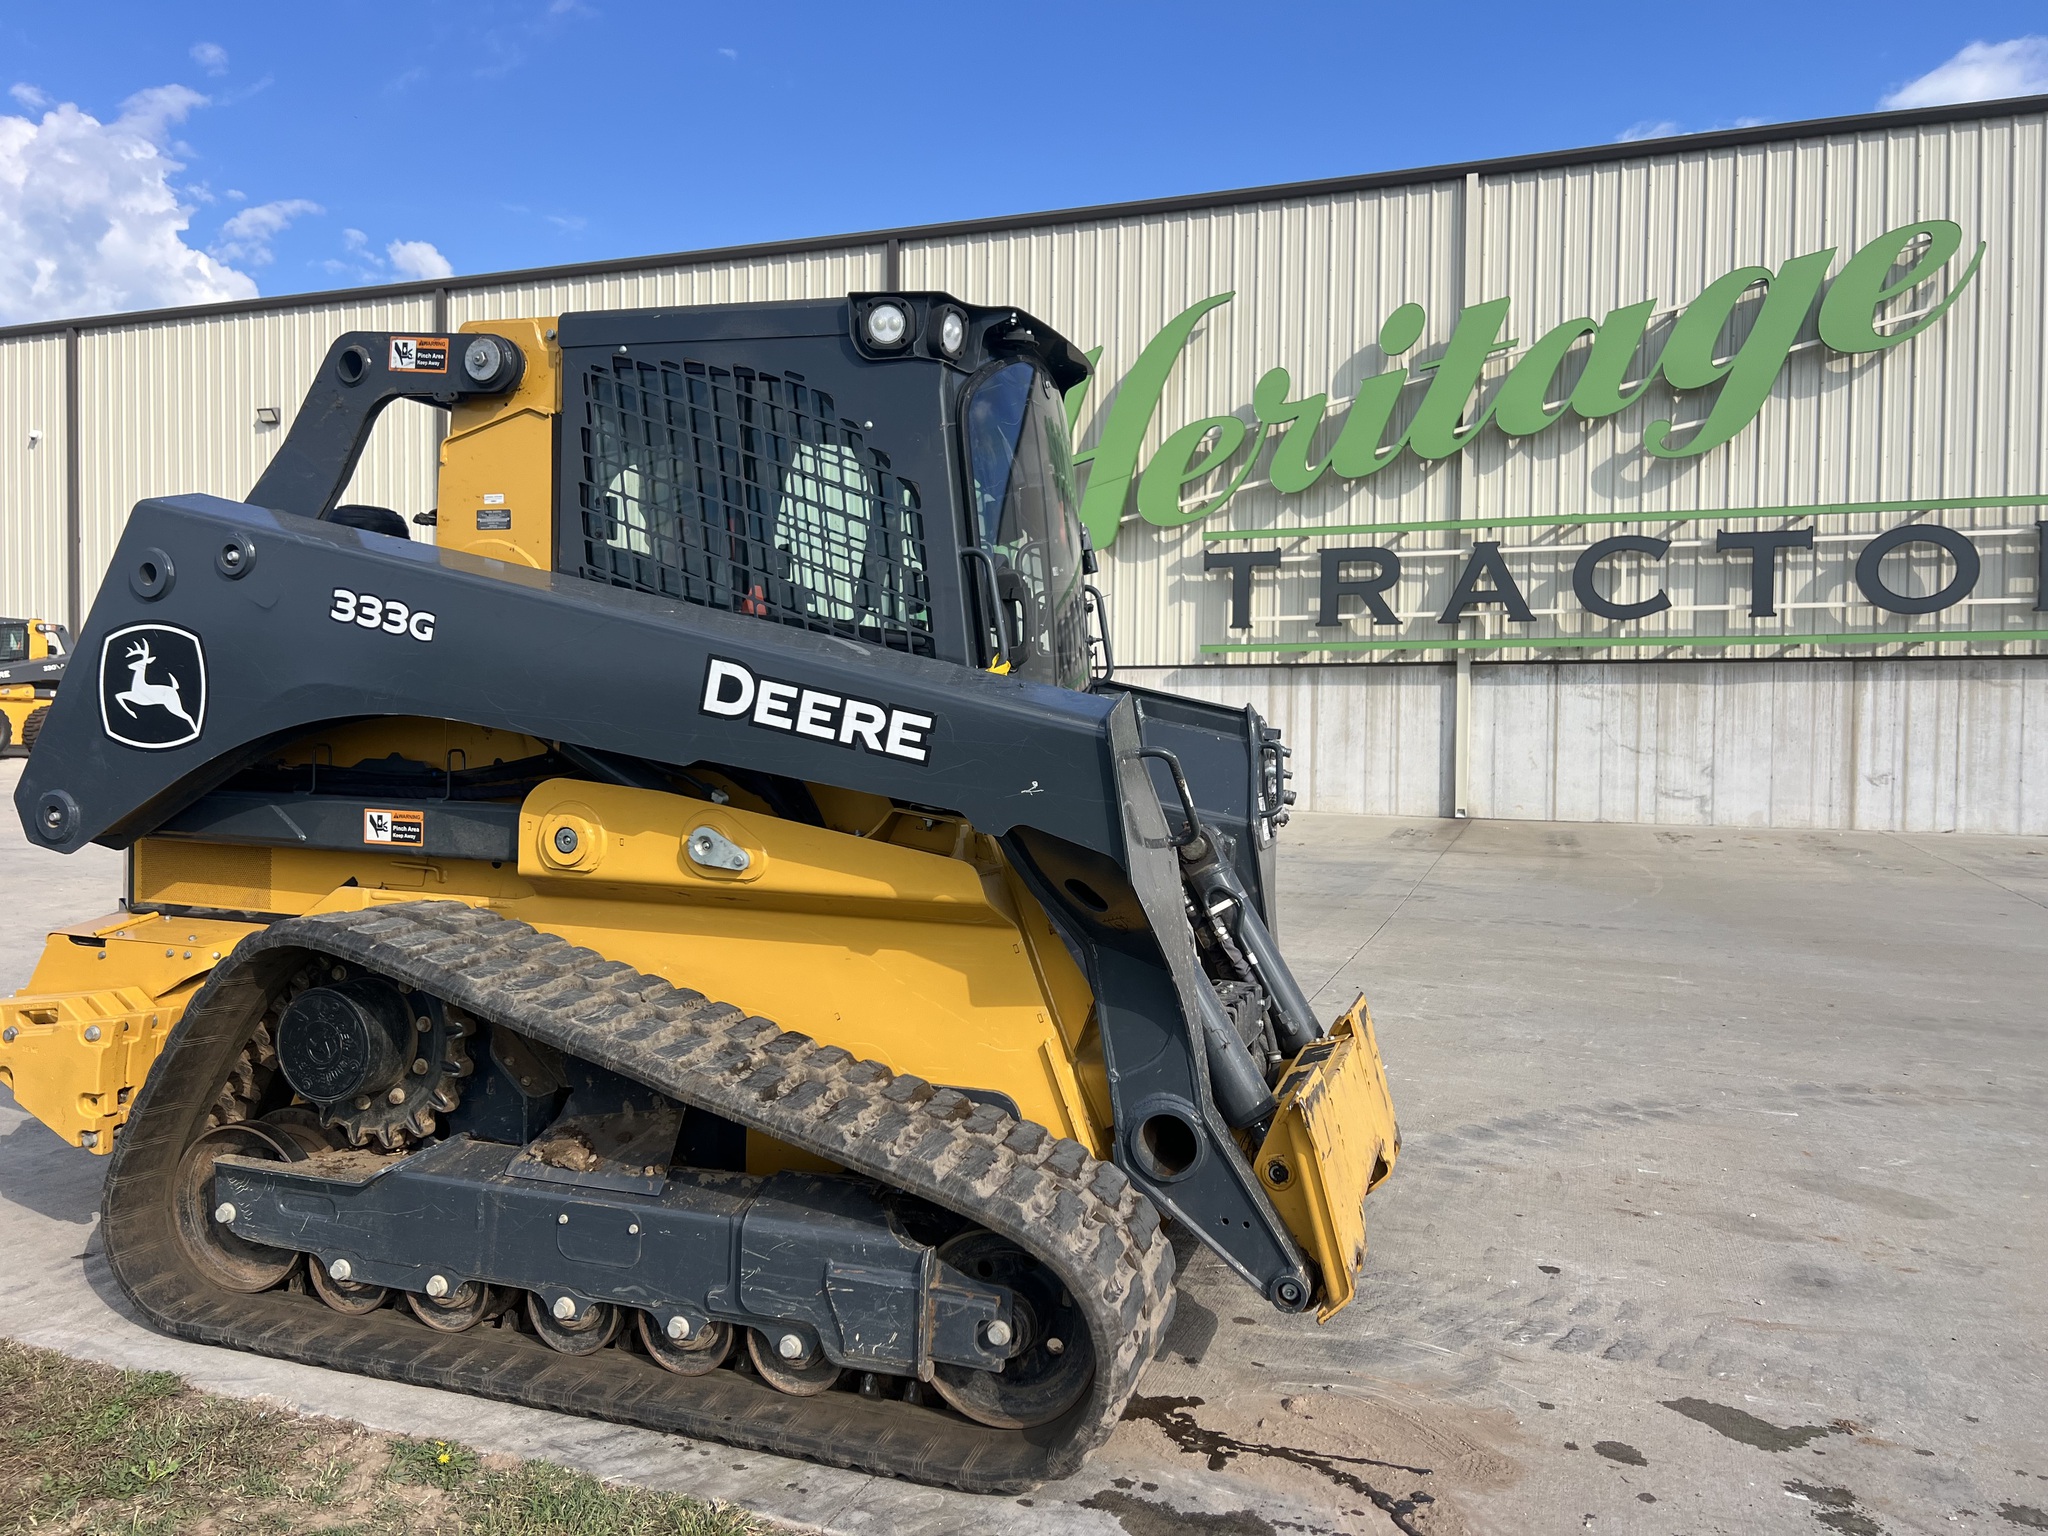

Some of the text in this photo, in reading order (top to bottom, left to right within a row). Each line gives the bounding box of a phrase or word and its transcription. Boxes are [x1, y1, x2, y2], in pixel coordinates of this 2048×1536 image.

[1064, 219, 1986, 552] Heritage
[330, 589, 436, 642] 333G
[1203, 521, 2048, 629] TRACTO
[702, 658, 932, 761] DEERE
